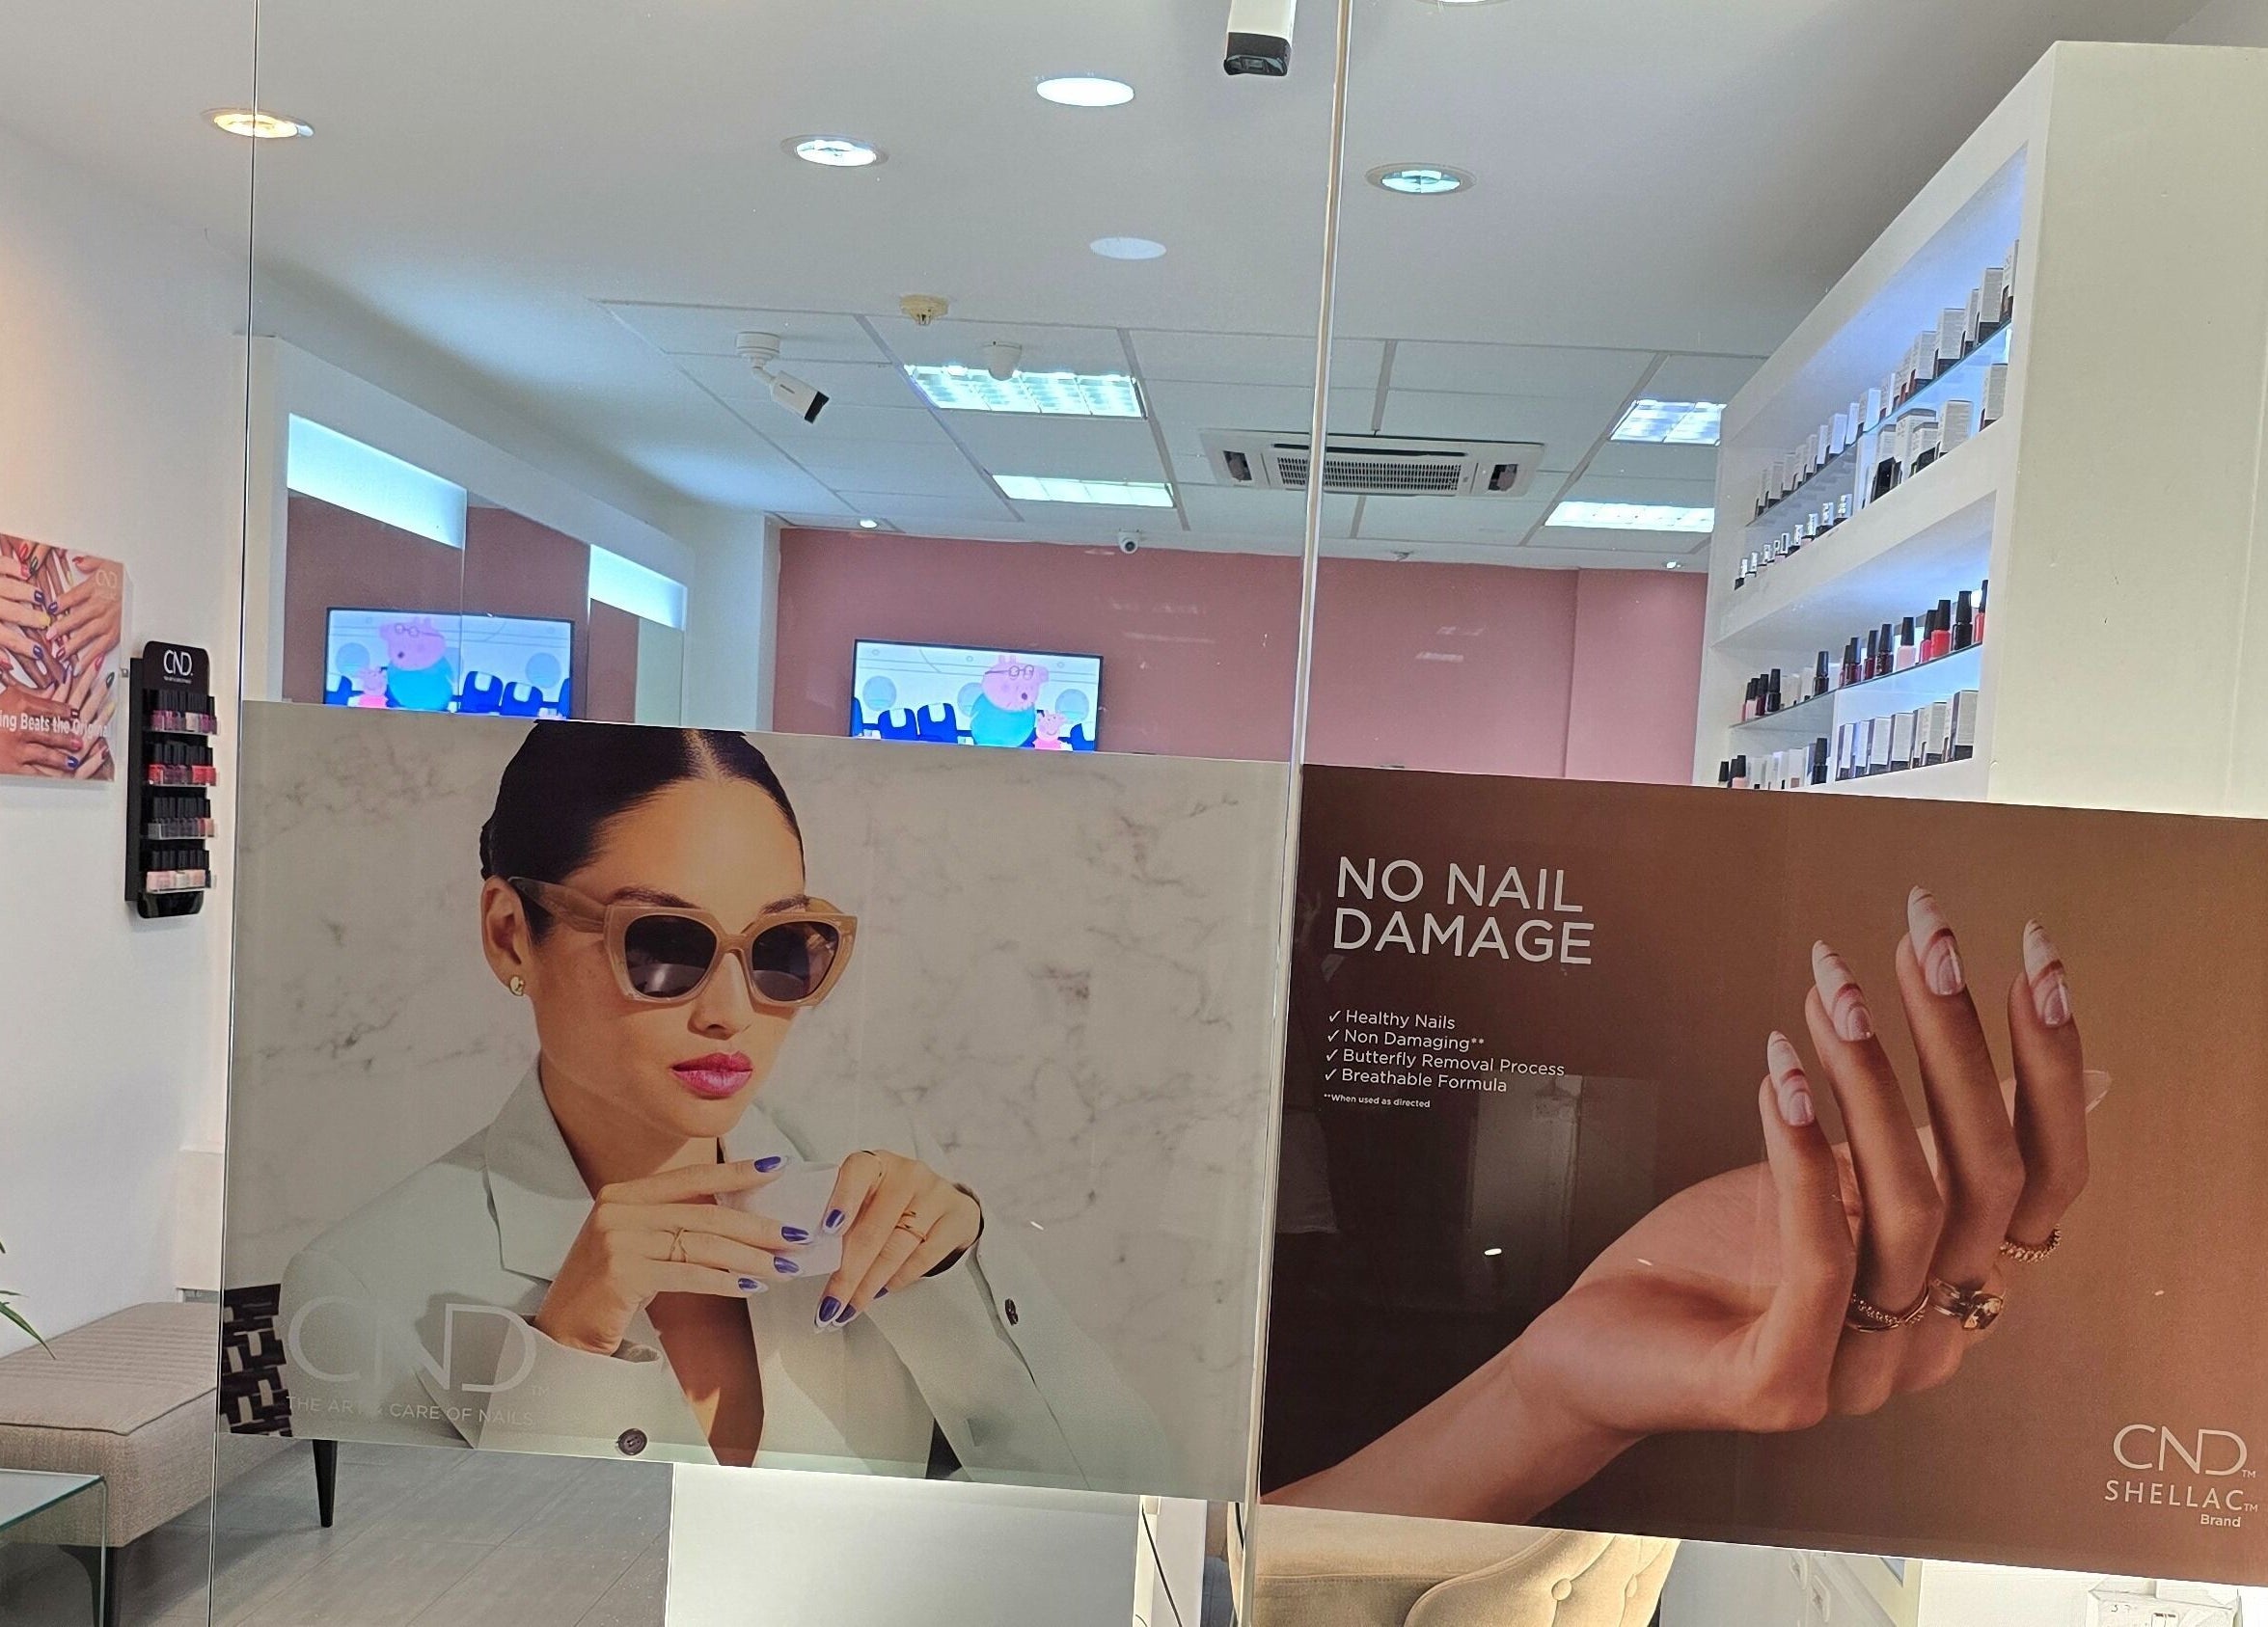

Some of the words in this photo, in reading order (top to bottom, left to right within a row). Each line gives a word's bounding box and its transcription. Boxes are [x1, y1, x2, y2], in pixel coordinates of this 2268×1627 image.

[164, 649, 192, 676] CND
[21, 712, 50, 732] Beats
[52, 716, 70, 734] the
[72, 719, 109, 740] Origina
[1337, 856, 1424, 902] NO
[1447, 863, 1584, 912] NAIL
[1333, 908, 1595, 964] DAMAGE
[1346, 1010, 1409, 1029] Healthy
[1414, 1014, 1456, 1030] Nails
[1344, 1029, 1379, 1044] Non
[1343, 1048, 1416, 1068] Butterfly
[1422, 1053, 1494, 1071] Removal
[1499, 1058, 1565, 1076] Process
[1342, 1068, 1433, 1087] Breathable
[1437, 1074, 1507, 1093] Formula
[1393, 1098, 1431, 1108] directed
[287, 1396, 321, 1412] THE
[390, 1403, 440, 1420] CARE
[448, 1407, 473, 1422] OF
[478, 1408, 533, 1425] NAILS
[2200, 1513, 2241, 1528] Brand
